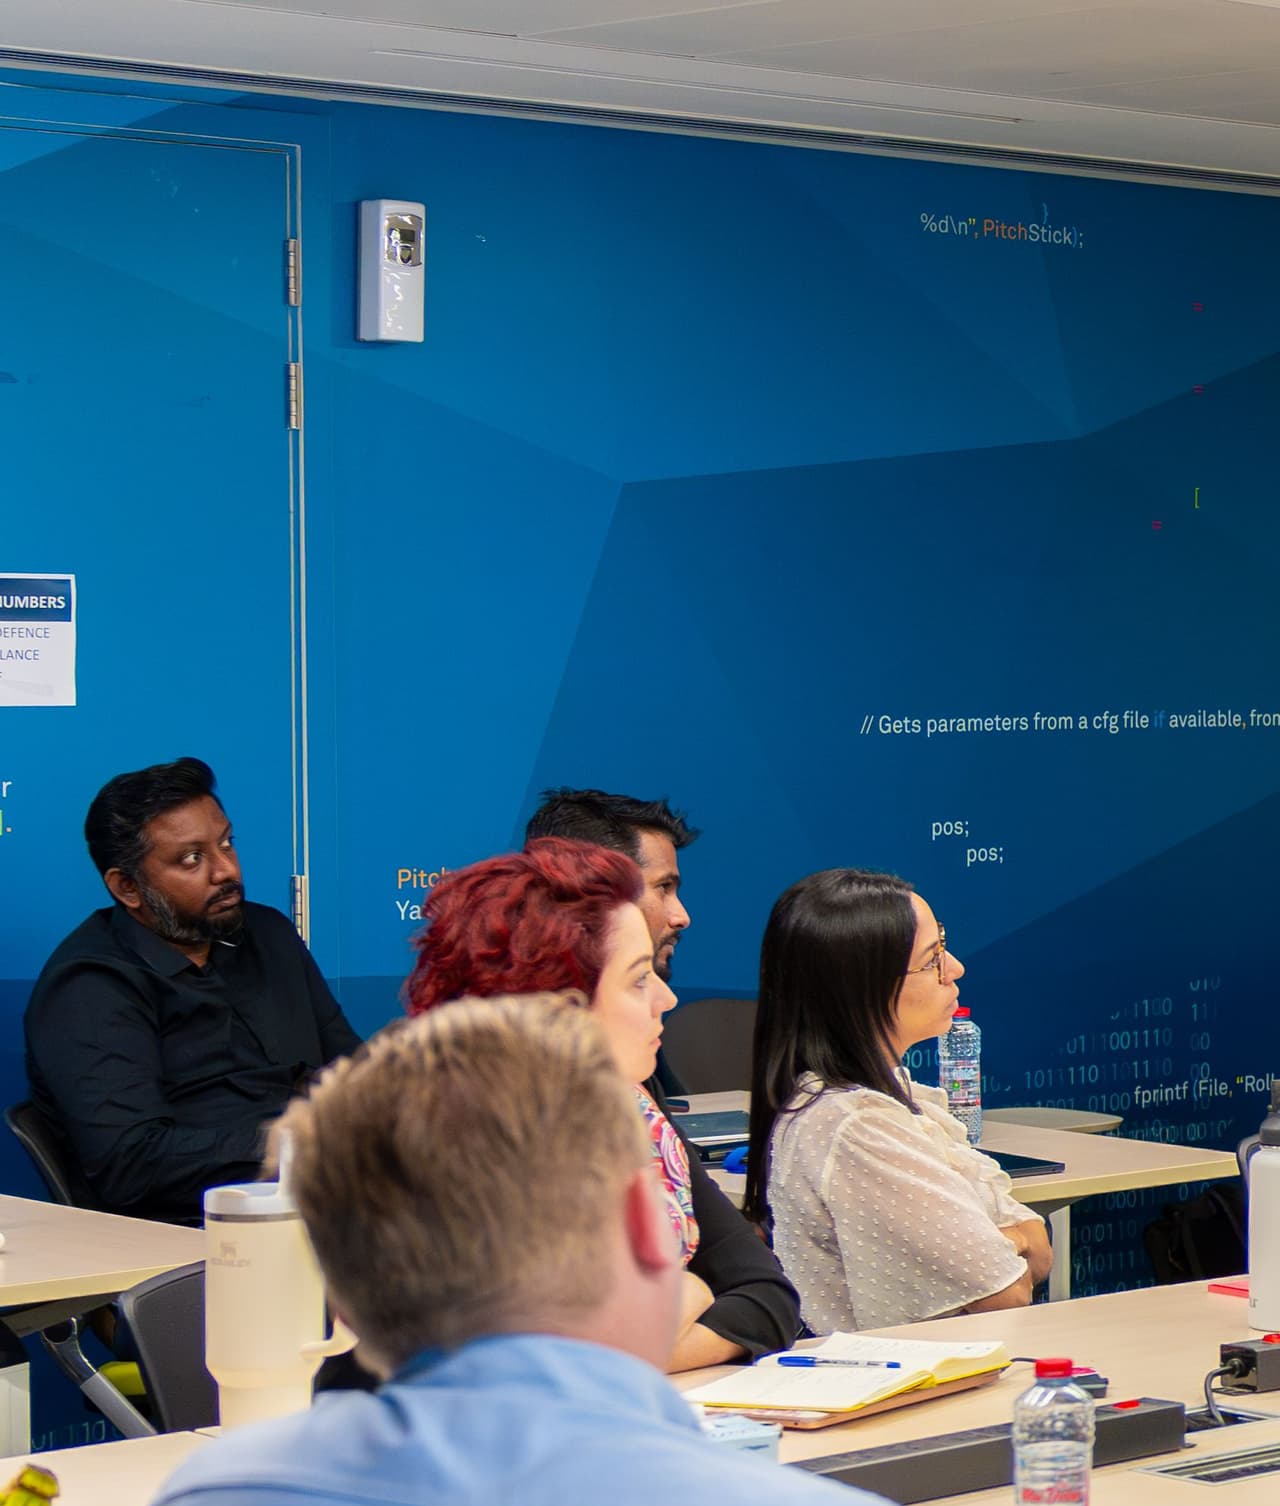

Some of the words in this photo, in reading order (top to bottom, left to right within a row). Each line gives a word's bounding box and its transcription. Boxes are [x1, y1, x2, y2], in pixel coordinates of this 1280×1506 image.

[878, 715, 922, 734] Gets
[926, 714, 1029, 737] parameters
[1033, 712, 1073, 731] from
[1078, 717, 1088, 730] a
[1092, 711, 1120, 733] cfg
[1122, 711, 1149, 729] file
[1154, 711, 1165, 728] if
[1168, 710, 1246, 730] available,
[931, 819, 970, 841] pos;
[966, 845, 1003, 867] pos;
[1134, 1081, 1189, 1109] fprintf
